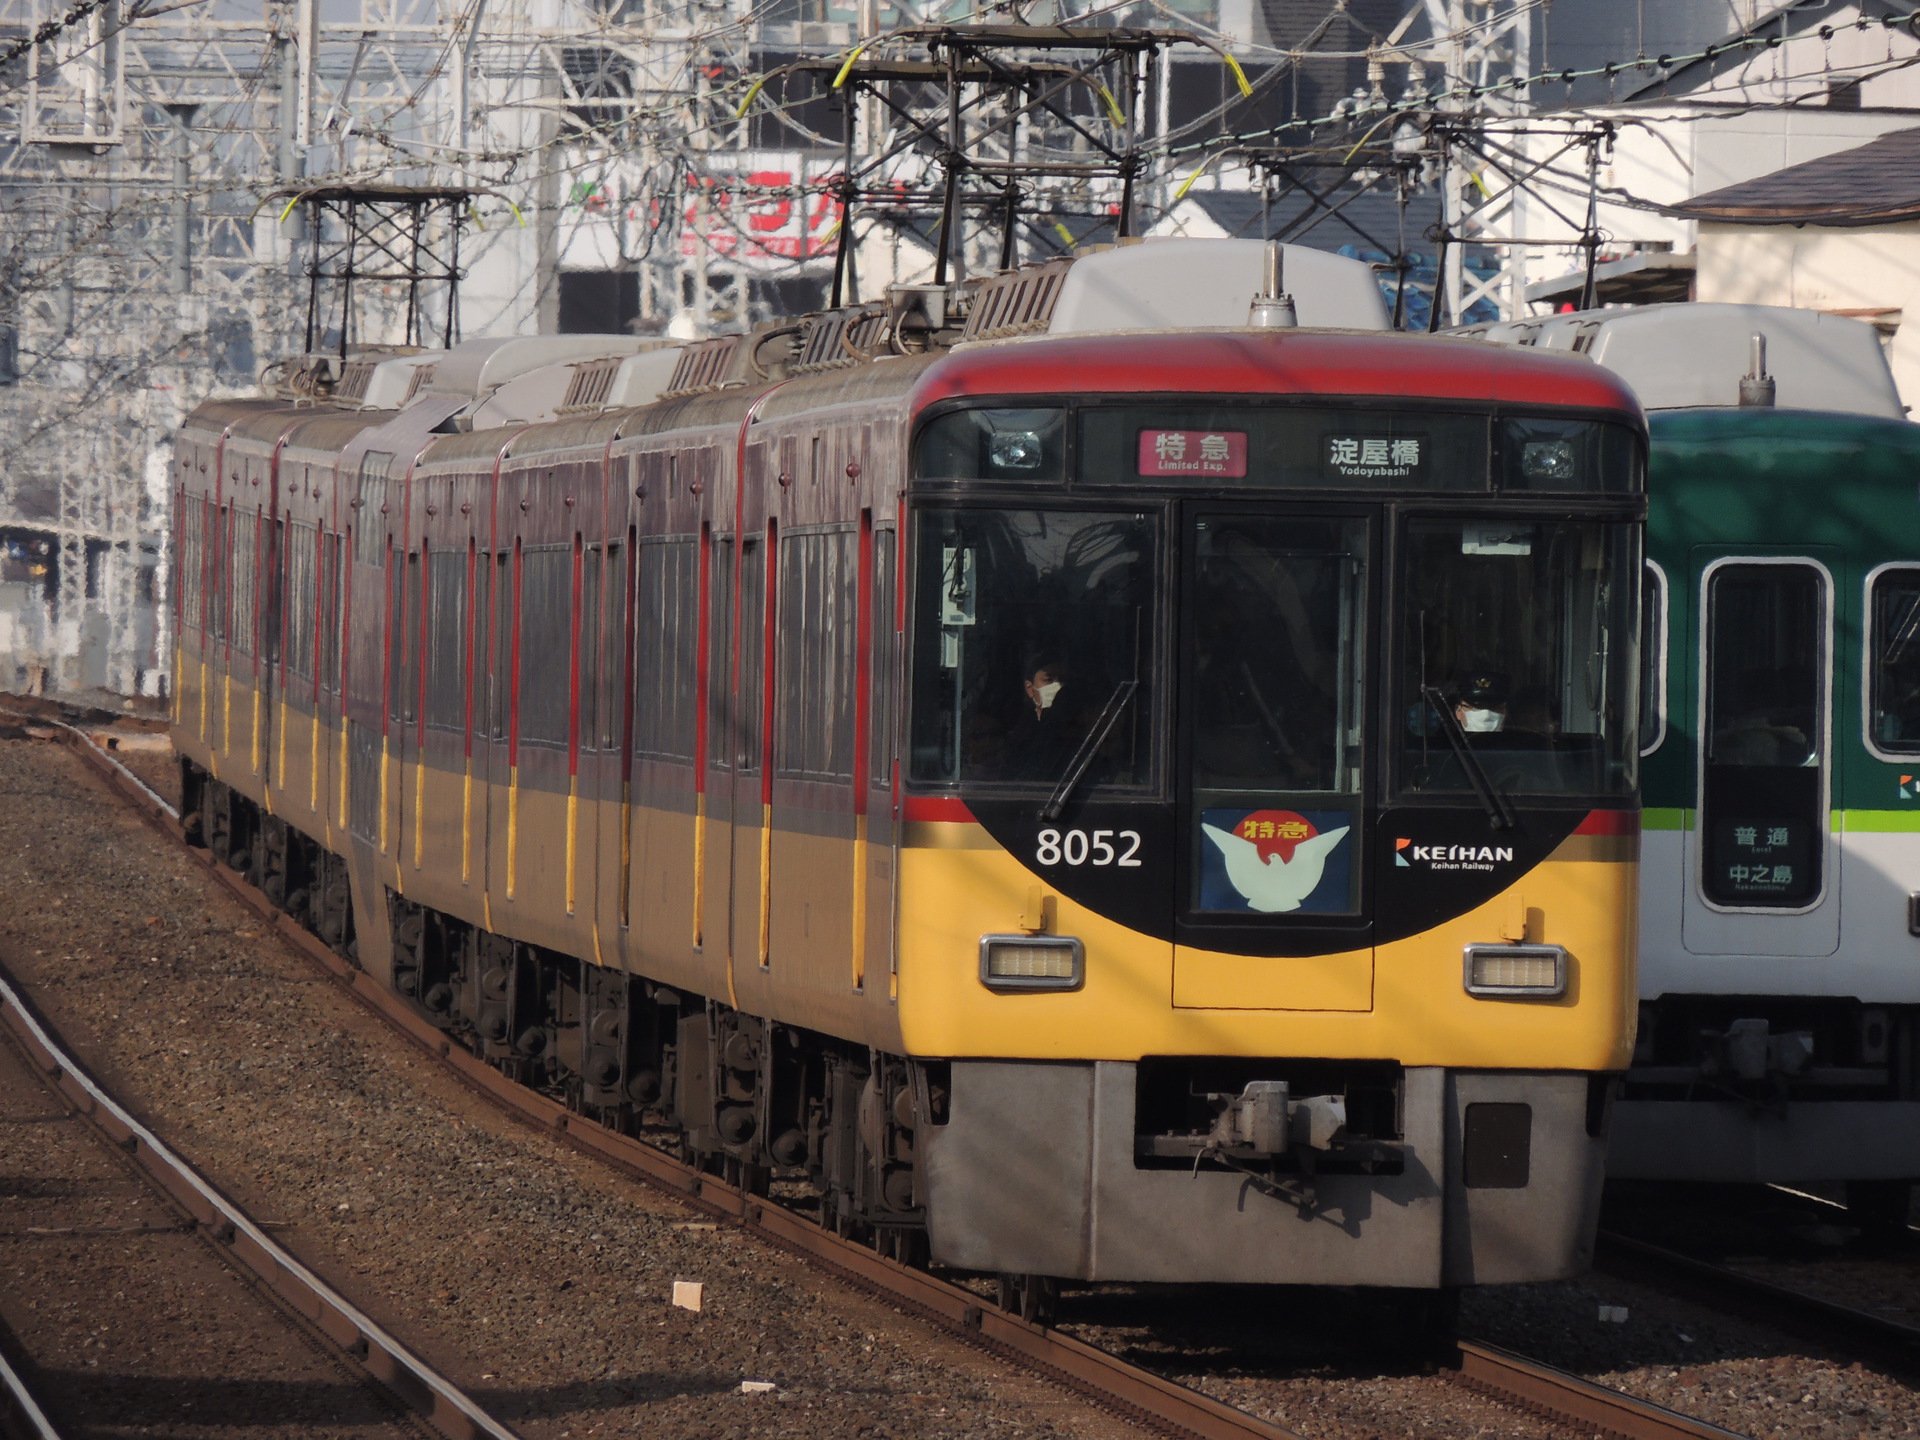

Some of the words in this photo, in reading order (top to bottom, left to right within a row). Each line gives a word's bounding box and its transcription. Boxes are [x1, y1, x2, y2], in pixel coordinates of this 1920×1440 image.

[1155, 433, 1230, 460] 特急
[1330, 438, 1420, 466] 淀屋橋
[1158, 460, 1199, 470] Limited
[1203, 461, 1226, 472] Exp.
[1339, 466, 1410, 478] Yodoyabashi
[1244, 820, 1308, 839] 特急
[1734, 826, 1788, 846] 普通
[1036, 828, 1142, 867] 8052
[1413, 844, 1513, 862] KEIHAN
[1431, 861, 1460, 870] Keihan
[1461, 862, 1495, 872] Railway
[1729, 864, 1793, 884] 中之島
